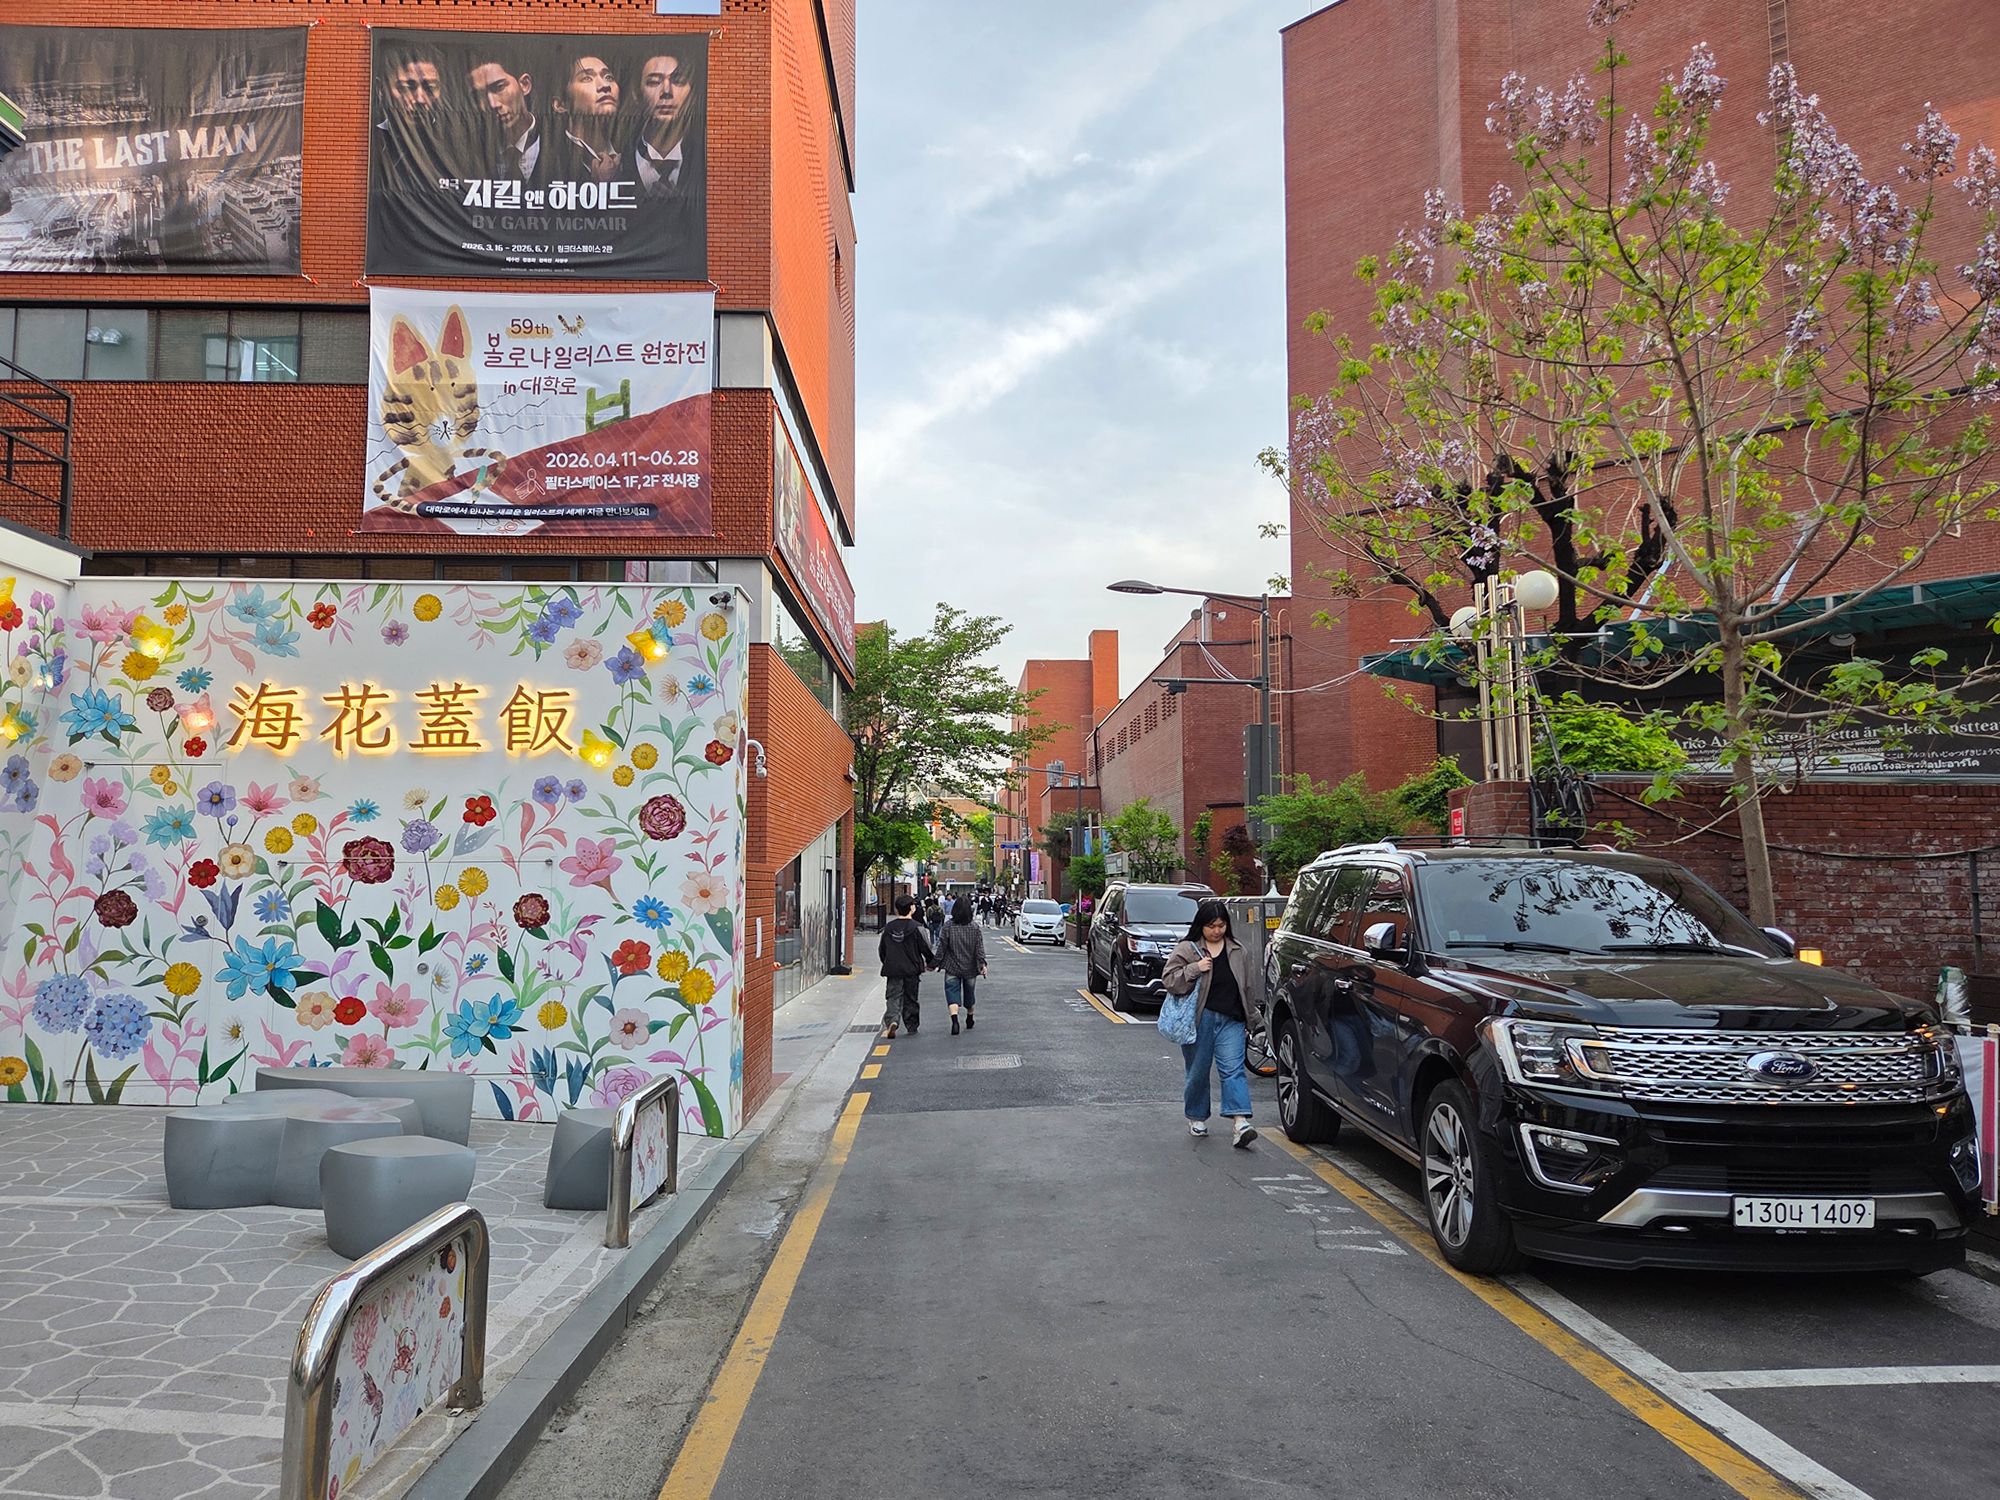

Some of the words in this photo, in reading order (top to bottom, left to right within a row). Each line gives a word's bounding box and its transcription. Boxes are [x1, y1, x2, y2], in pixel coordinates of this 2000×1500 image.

[25, 138, 86, 174] THE
[92, 130, 170, 169] LAST
[177, 123, 257, 160] MAN
[438, 178, 459, 190] 연극
[462, 179, 521, 209] 지킬
[524, 190, 544, 210] 앤
[548, 180, 637, 210] 하이드
[472, 216, 496, 229] BY
[501, 217, 550, 230] GARY
[510, 318, 549, 335] 59th
[640, 340, 706, 365] 원화전
[520, 376, 578, 395] 대학로
[545, 450, 699, 468] 2026.04.11~06.28
[545, 475, 621, 490] 필더스페이스
[661, 473, 700, 488] 전시장
[425, 505, 468, 515] 대학로에서
[226, 681, 573, 750] 海花蓋飯
[1771, 1060, 1803, 1073] Ford
[1745, 1202, 1803, 1223] 130나
[1811, 1204, 1866, 1224] 1409
